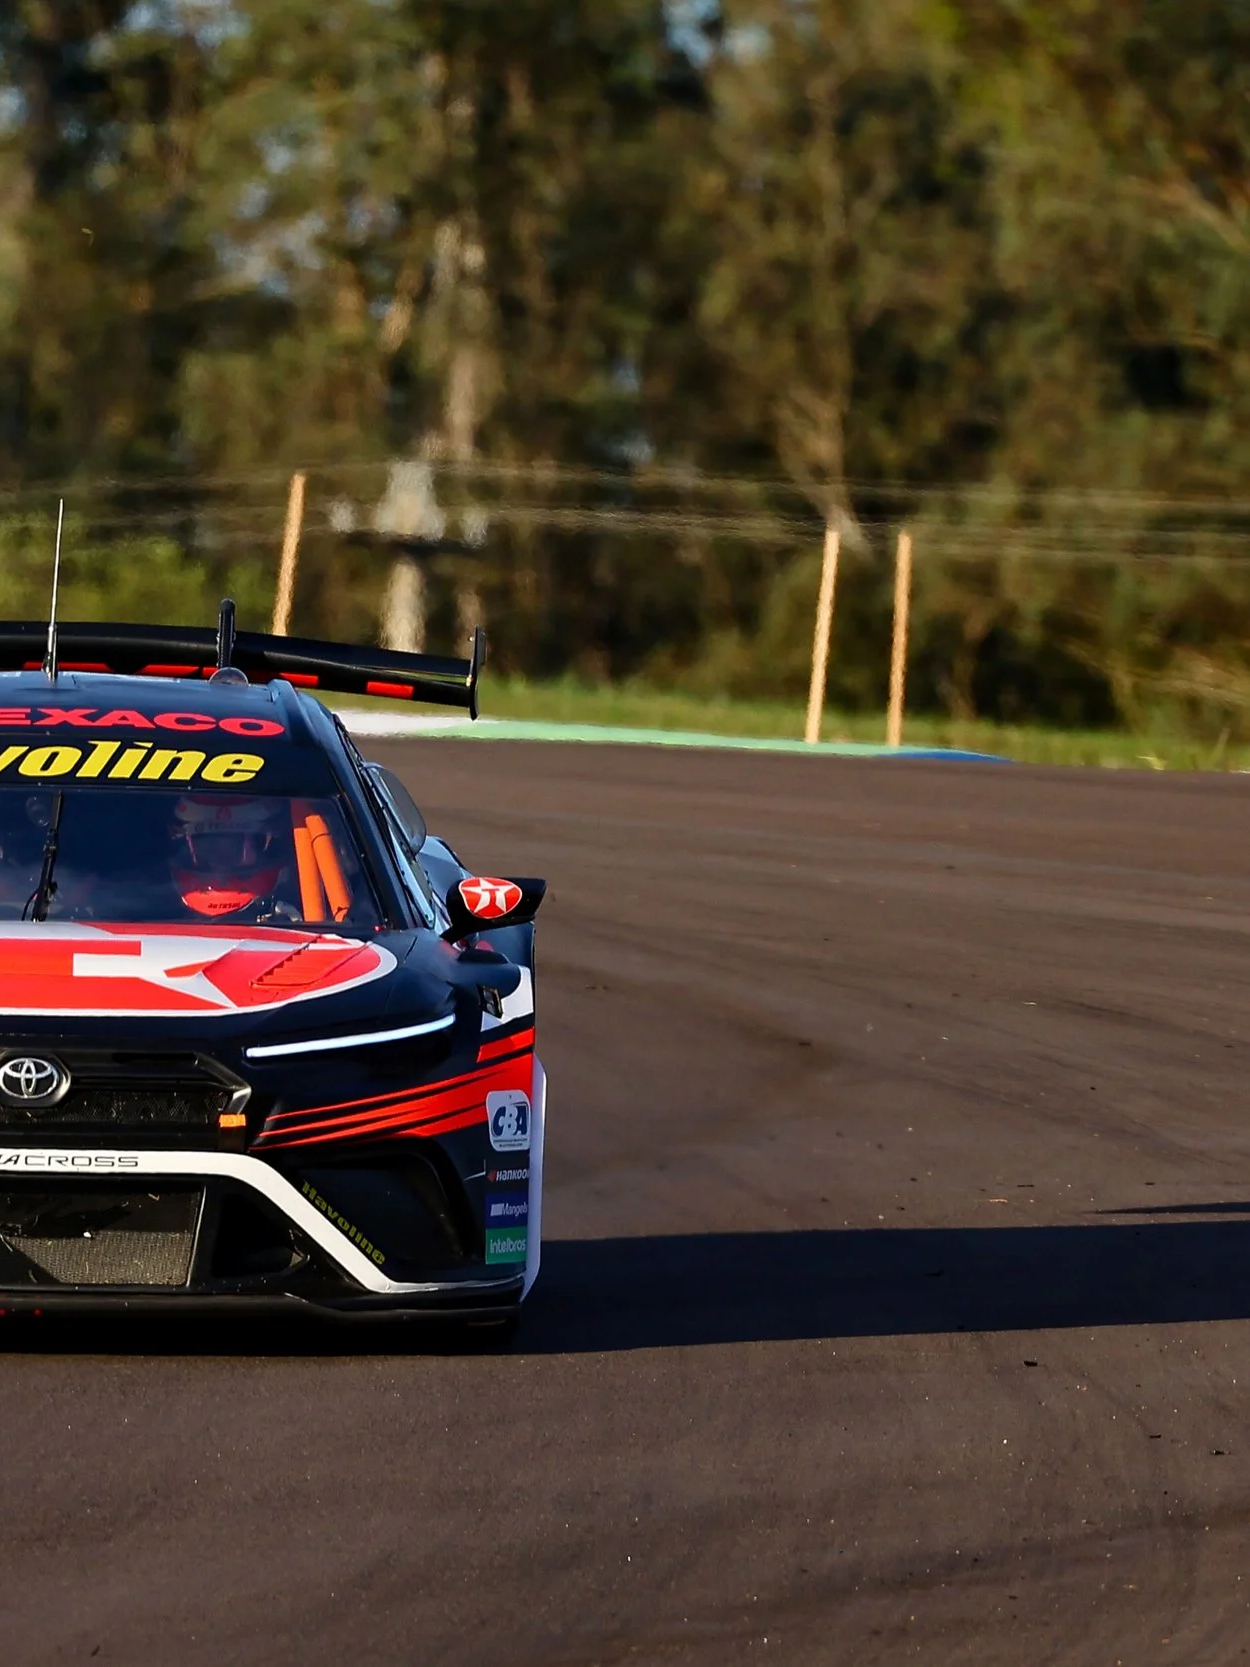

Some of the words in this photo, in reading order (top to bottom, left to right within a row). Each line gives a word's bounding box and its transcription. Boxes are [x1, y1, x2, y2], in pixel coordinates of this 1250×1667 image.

[492, 1104, 528, 1136] CBA
[24, 1155, 139, 1167] CROSS
[302, 1180, 386, 1265] Havoline
[490, 1238, 526, 1254] intelbros
